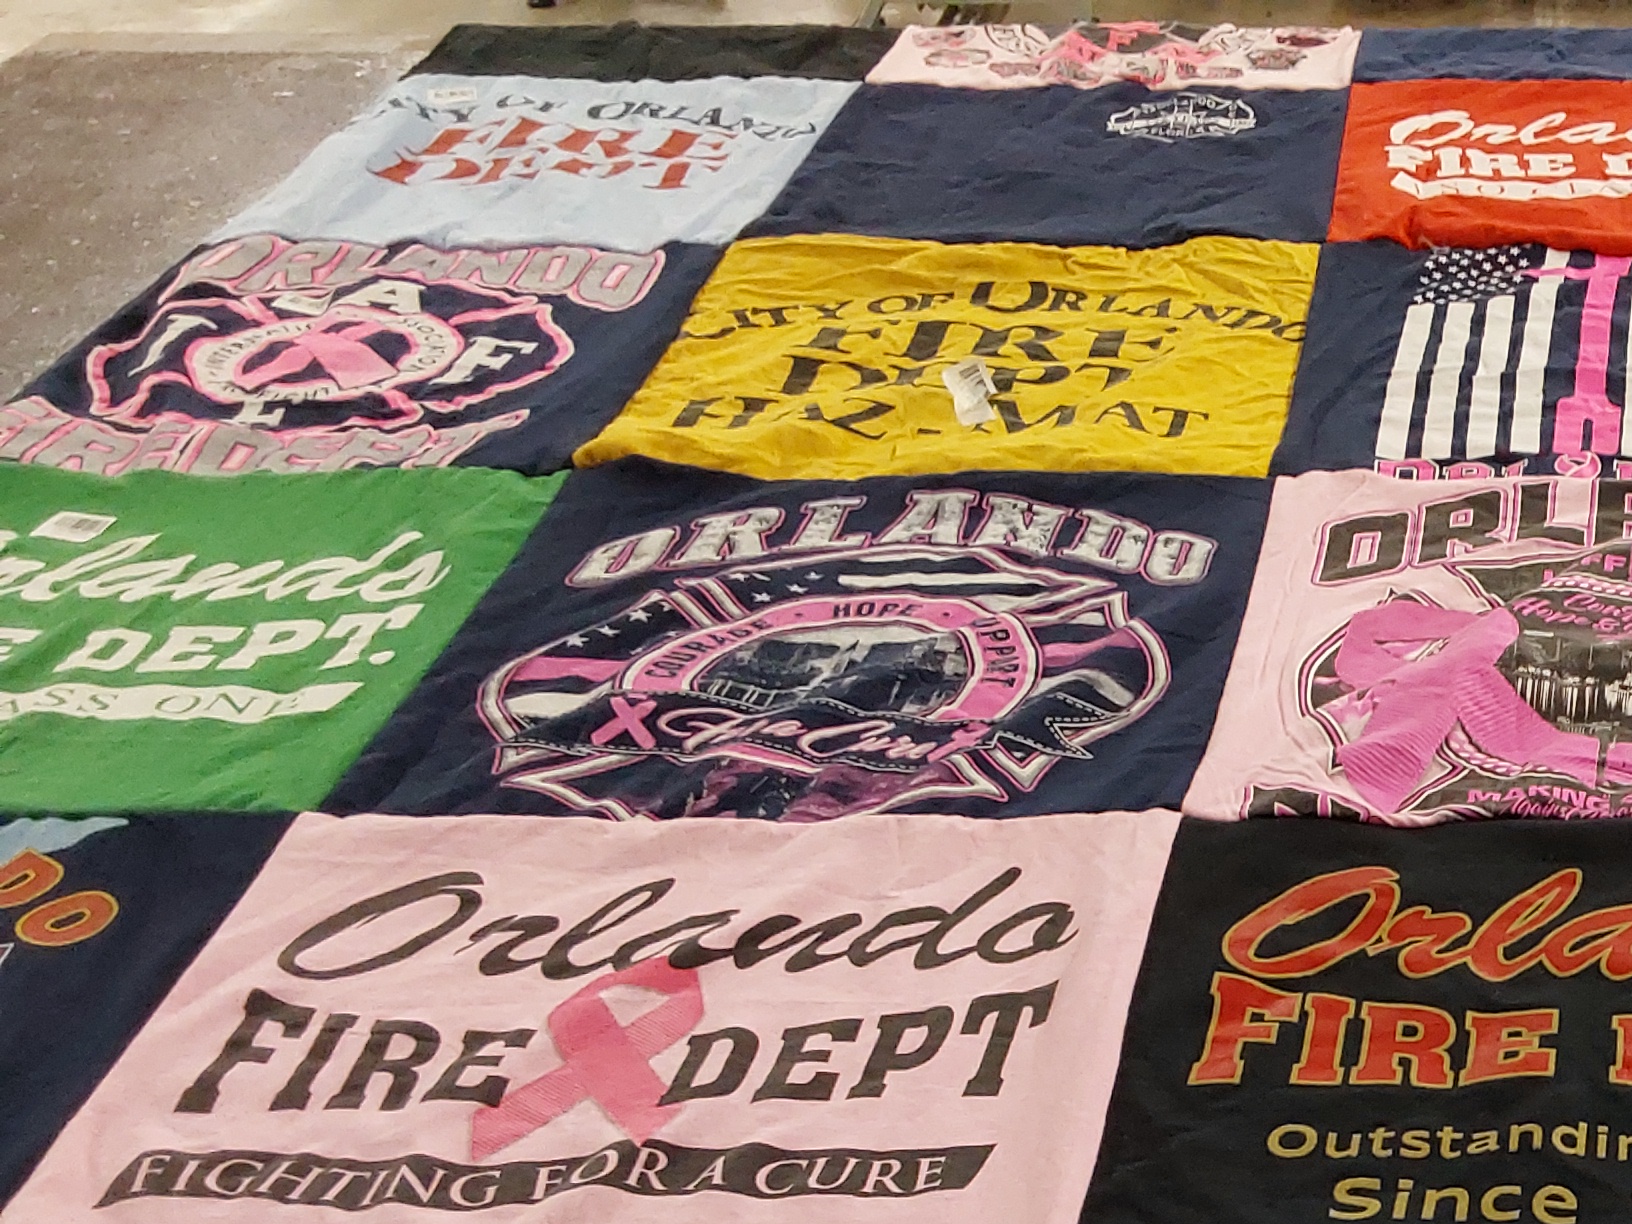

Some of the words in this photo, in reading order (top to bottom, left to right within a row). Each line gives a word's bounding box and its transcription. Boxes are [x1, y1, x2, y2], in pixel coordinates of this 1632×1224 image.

[1384, 143, 1575, 178] FIRE
[159, 235, 665, 311] ORLANDO
[882, 292, 957, 315] OF
[800, 320, 1182, 364] FIRE
[0, 530, 451, 602] rlando
[564, 488, 1219, 588] ORLANDO
[52, 603, 425, 674] DEPT.
[832, 600, 923, 619] HOPE
[153, 692, 301, 718] ONE
[276, 867, 1079, 982] Orlando
[172, 988, 537, 1115] FIRE
[655, 981, 1060, 1109] DEPT
[1188, 972, 1561, 1089] FIRE
[131, 1152, 500, 1208] FIGHTING
[535, 1138, 668, 1207] FOR
[694, 1154, 728, 1188] A
[755, 1155, 945, 1196] CURE
